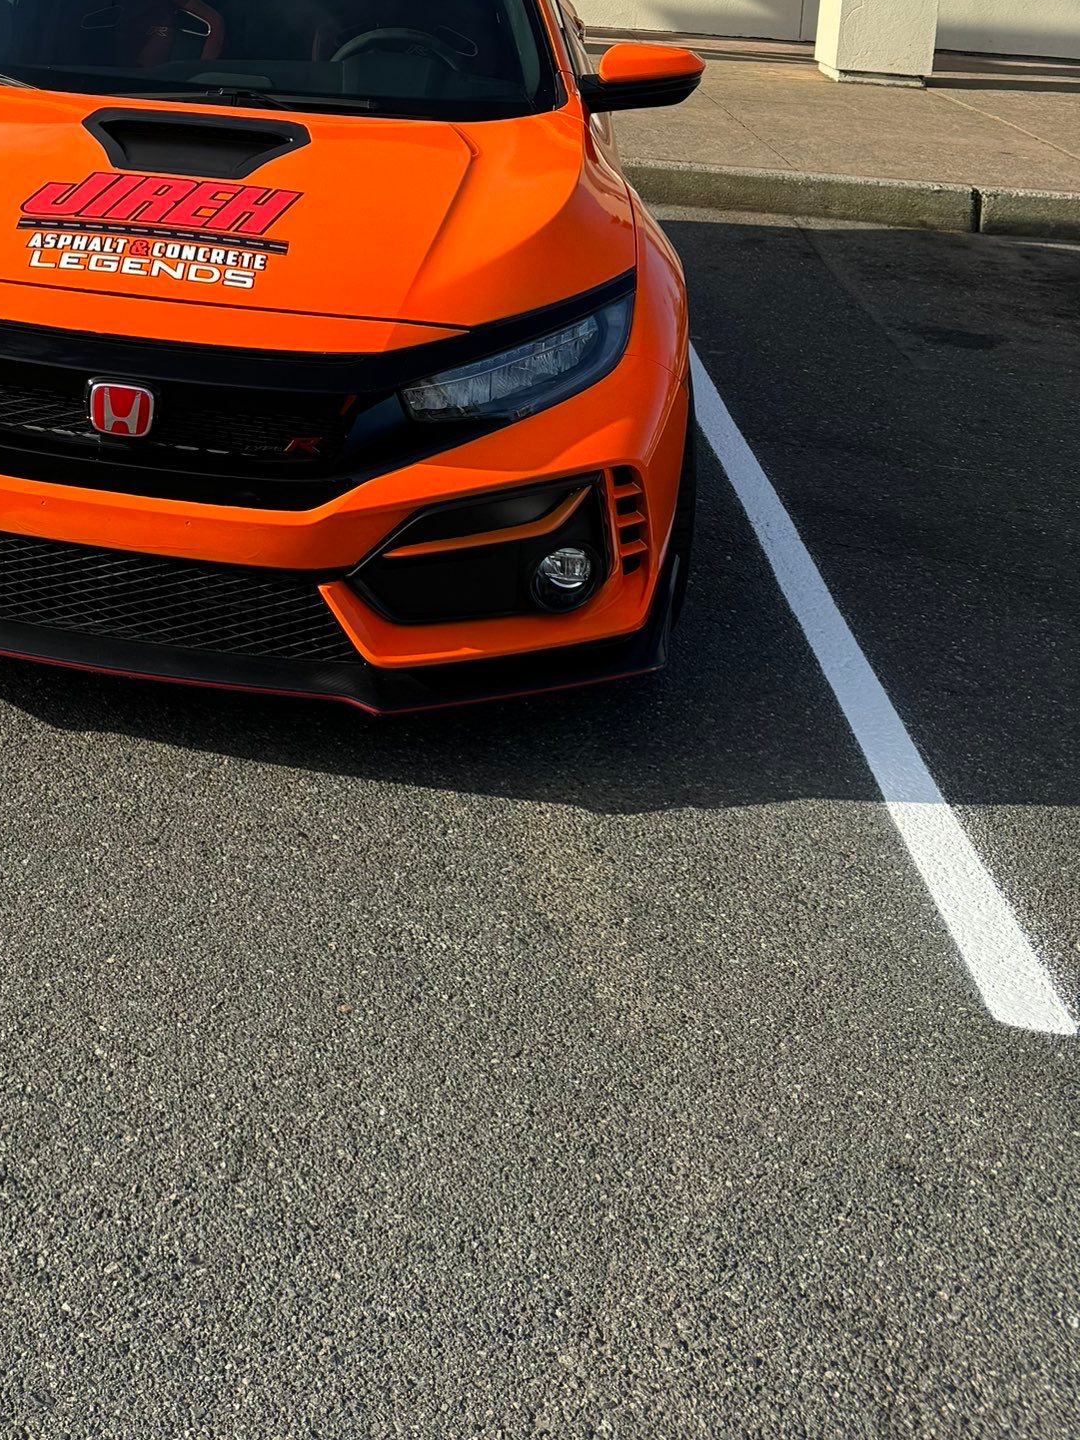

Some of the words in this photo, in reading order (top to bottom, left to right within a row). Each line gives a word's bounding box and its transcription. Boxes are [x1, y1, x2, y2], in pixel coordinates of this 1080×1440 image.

[20, 172, 304, 236] JIREH
[26, 231, 130, 255] ASPHALT
[128, 240, 150, 256] &
[151, 241, 268, 271] CONCRETE
[28, 249, 256, 289] LEGENDS
[283, 436, 322, 453] R
